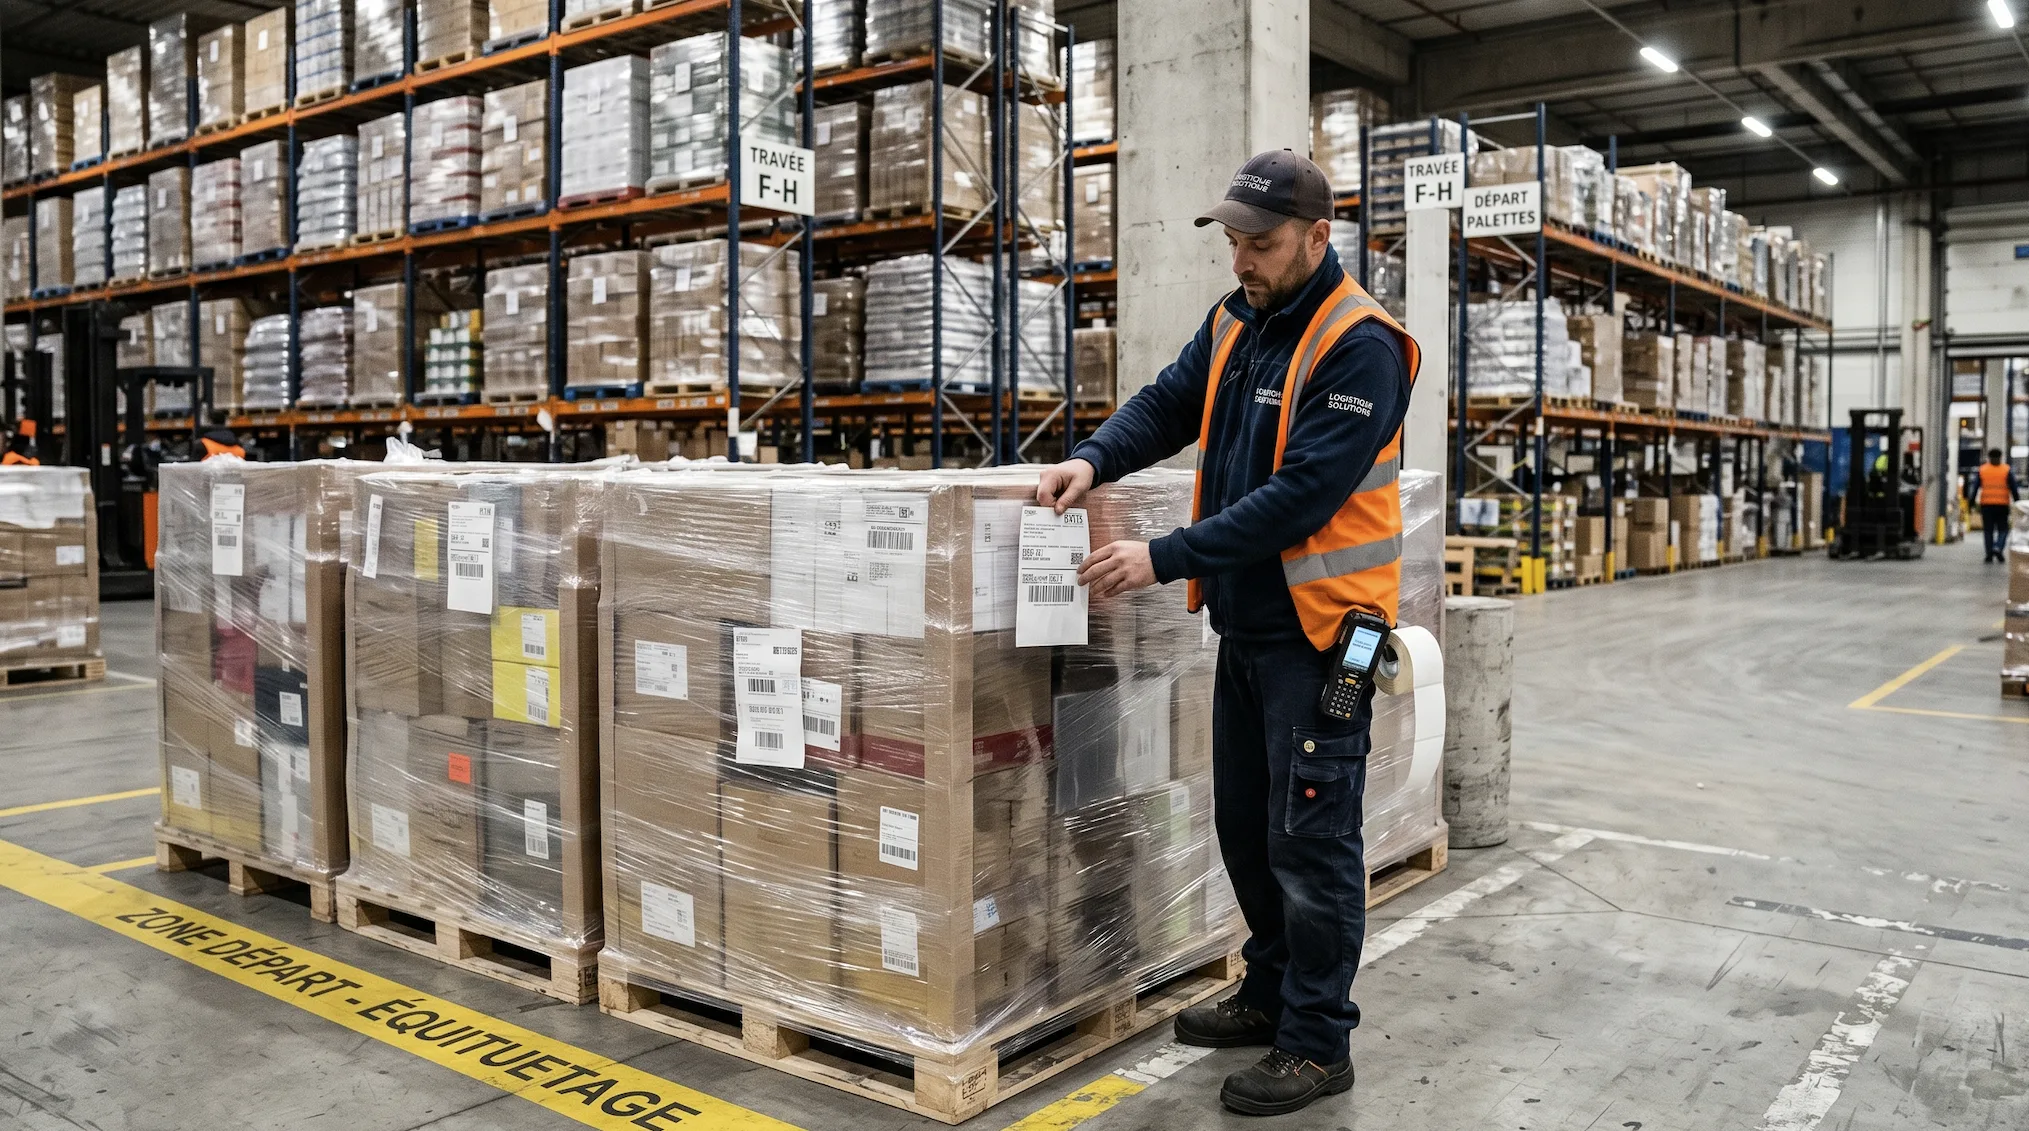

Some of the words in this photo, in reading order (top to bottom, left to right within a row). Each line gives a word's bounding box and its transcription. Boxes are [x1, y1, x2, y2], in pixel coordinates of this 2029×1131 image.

[750, 147, 804, 173] TRAVÉE
[1408, 157, 1459, 177] TRAVÉE
[759, 174, 797, 204] F-H
[1415, 181, 1452, 203] F-H
[1474, 190, 1528, 208] DÉPART
[1467, 211, 1536, 228] PALETTES
[115, 907, 228, 946] ZONE
[197, 939, 363, 998] DÉPART
[356, 998, 702, 1131] ÉQUITUETAGE
